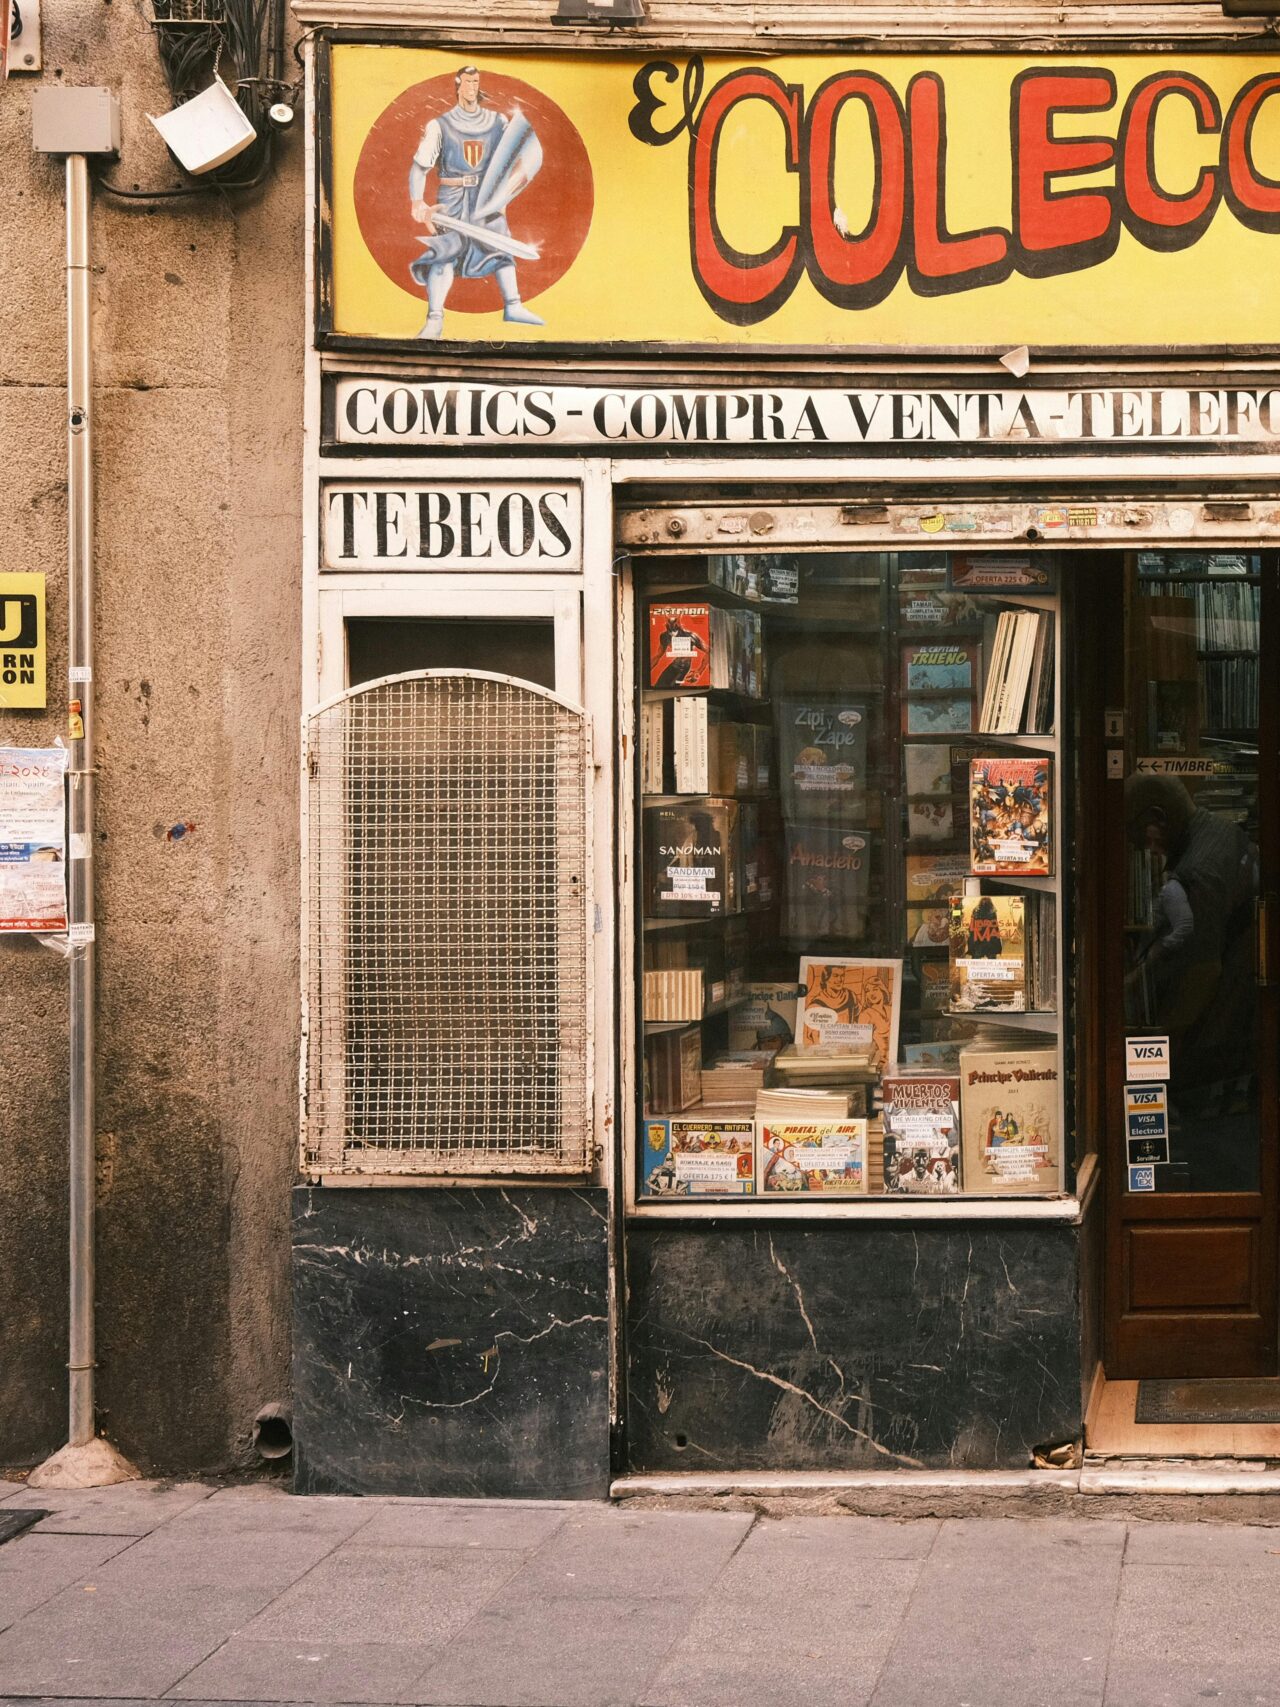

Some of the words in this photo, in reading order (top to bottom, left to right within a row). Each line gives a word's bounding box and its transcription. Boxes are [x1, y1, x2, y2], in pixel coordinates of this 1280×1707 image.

[628, 55, 705, 146] El
[346, 388, 556, 436] COMICS
[593, 394, 829, 440] COMPRA
[846, 393, 1044, 440] VENTA
[329, 492, 572, 559] TEBEOS
[912, 652, 967, 665] TRUENO
[795, 707, 824, 730] Zipi
[814, 727, 855, 749] Zape
[1164, 760, 1212, 772] TIMBRE
[668, 868, 714, 876] SANDMAN
[1134, 1047, 1163, 1058] VISA
[968, 1069, 1012, 1086] Principe
[1012, 1068, 1058, 1083] Valiente
[892, 1083, 952, 1099] MUERTOS
[893, 1098, 950, 1109] VIVIENTES
[1133, 1094, 1158, 1104] VISA
[784, 1126, 818, 1134] PIRATAS
[836, 1126, 857, 1134] AIRE
[1131, 1127, 1163, 1136] Electron
